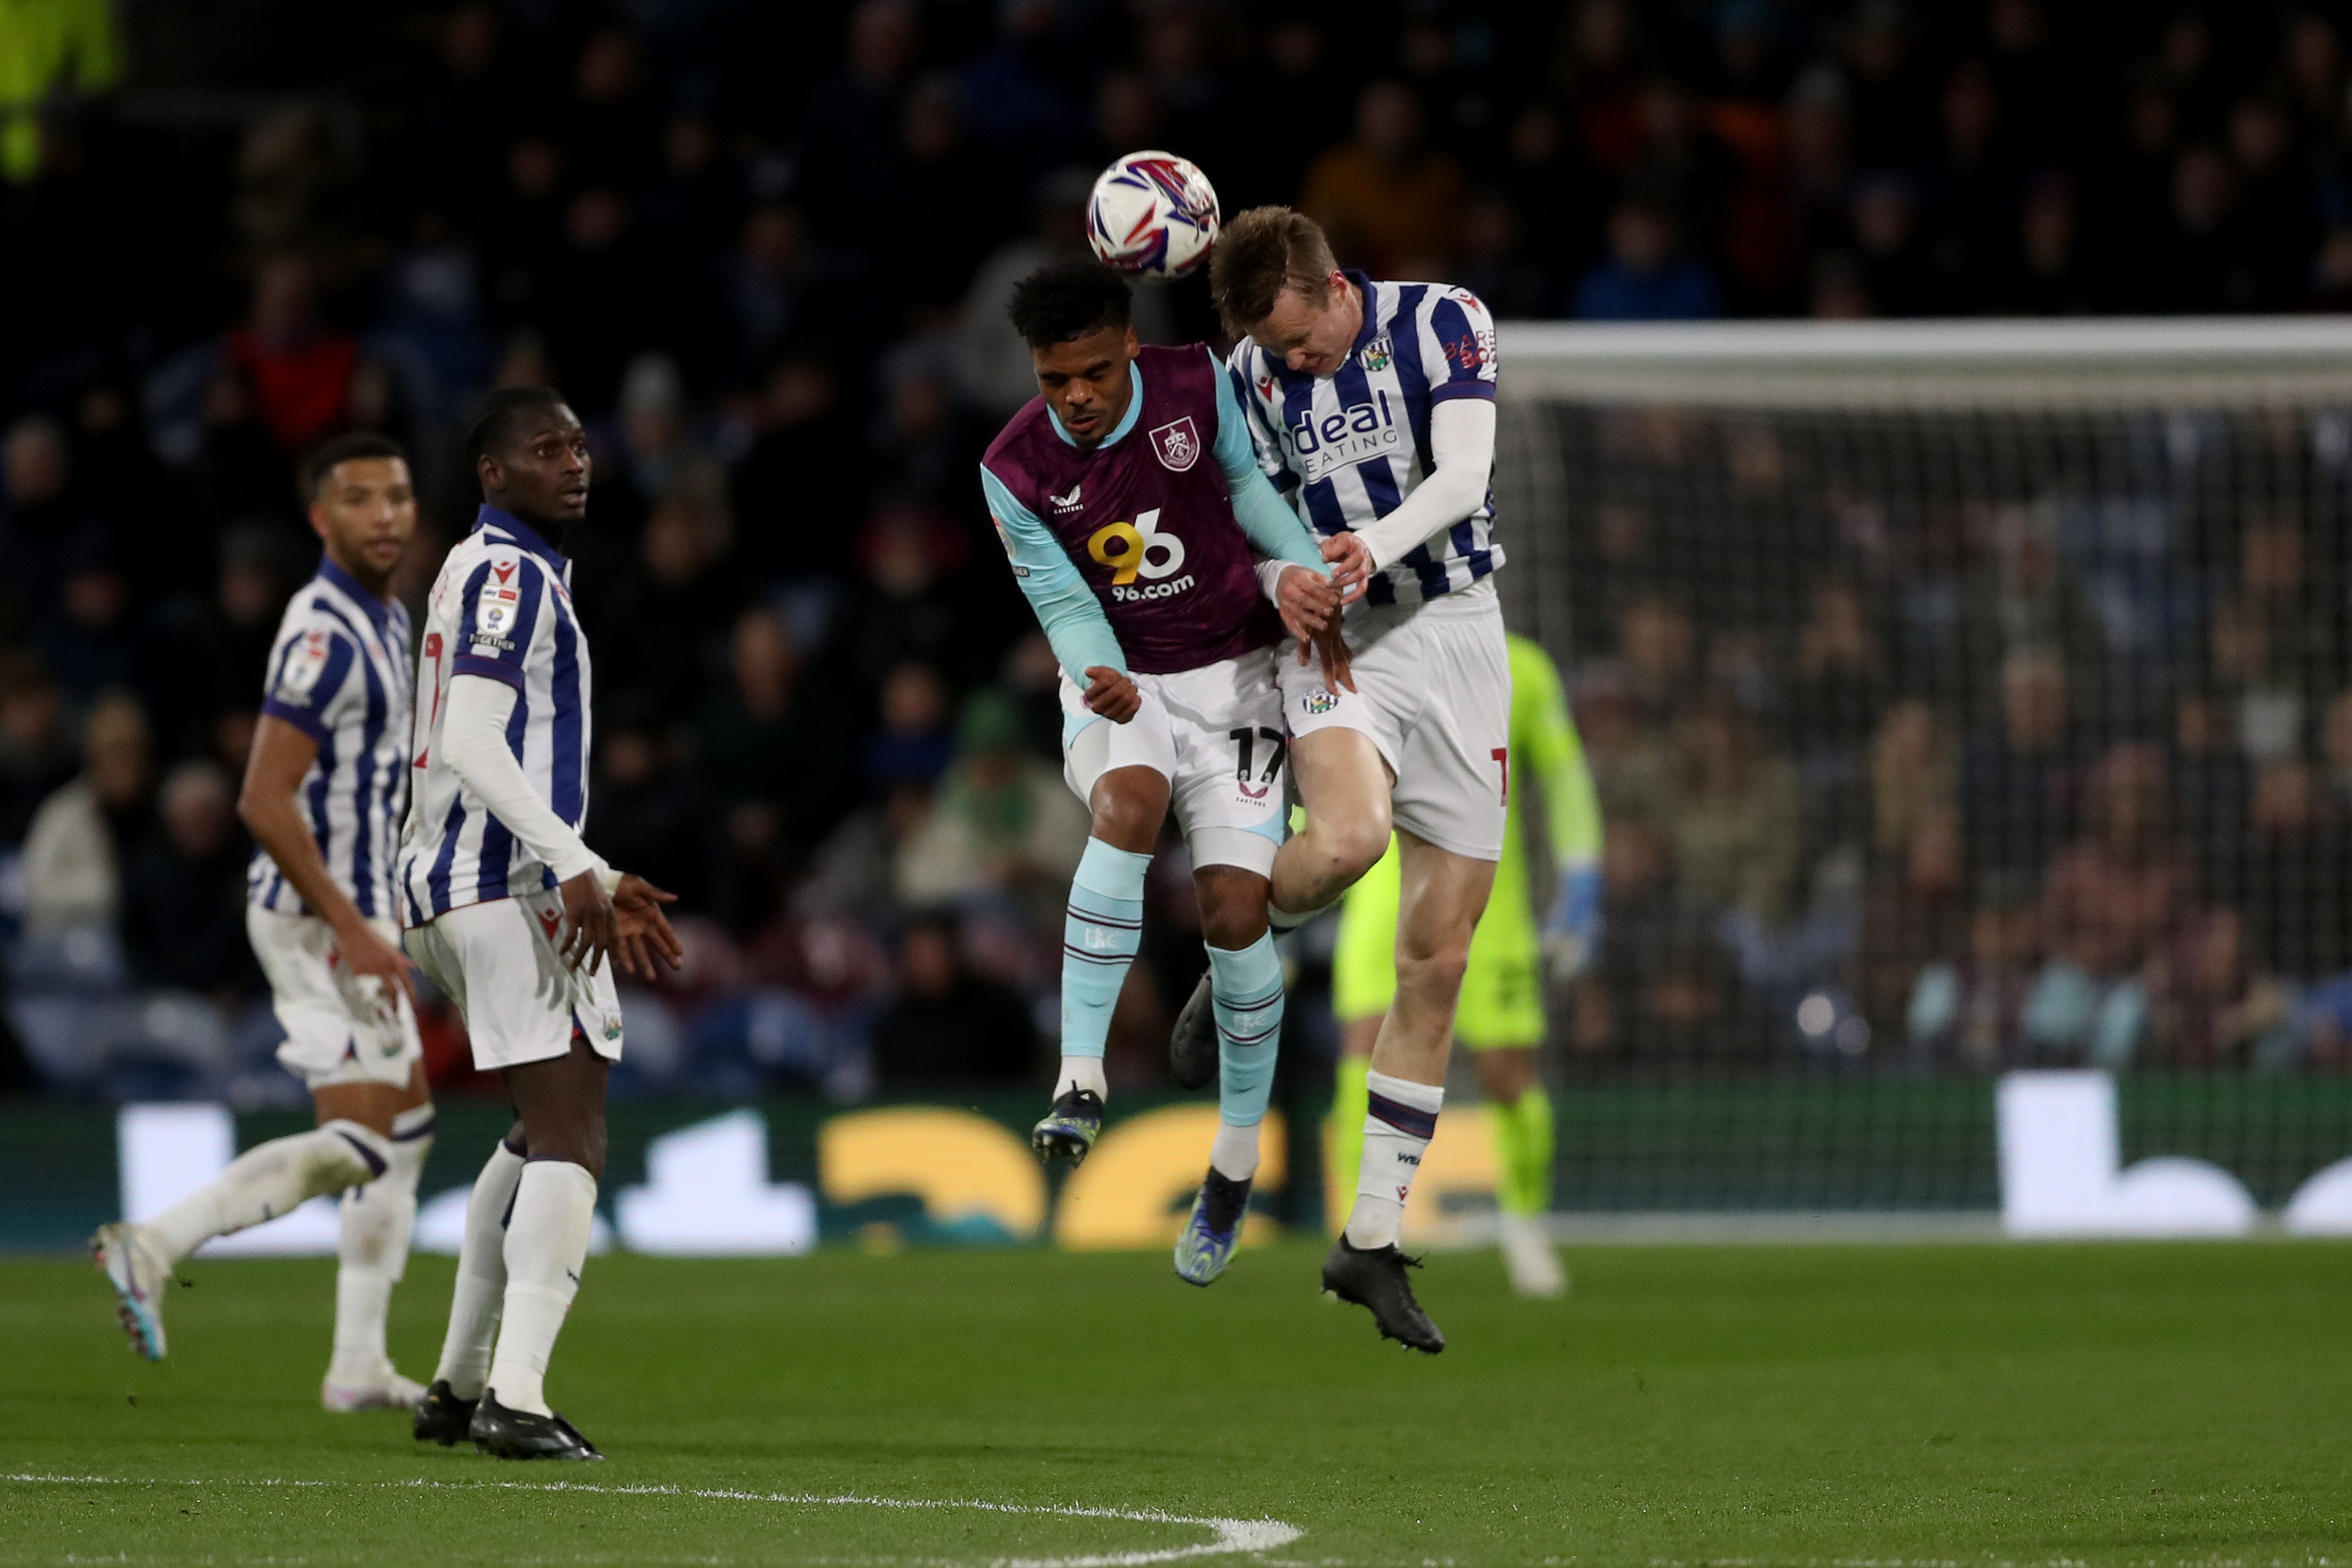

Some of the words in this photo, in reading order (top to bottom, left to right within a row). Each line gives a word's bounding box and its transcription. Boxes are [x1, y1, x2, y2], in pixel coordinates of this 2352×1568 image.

[1298, 430, 1397, 474] EATING
[1087, 508, 1185, 586] 96
[1111, 574, 1195, 602] 96.com
[1230, 726, 1286, 784] 17
